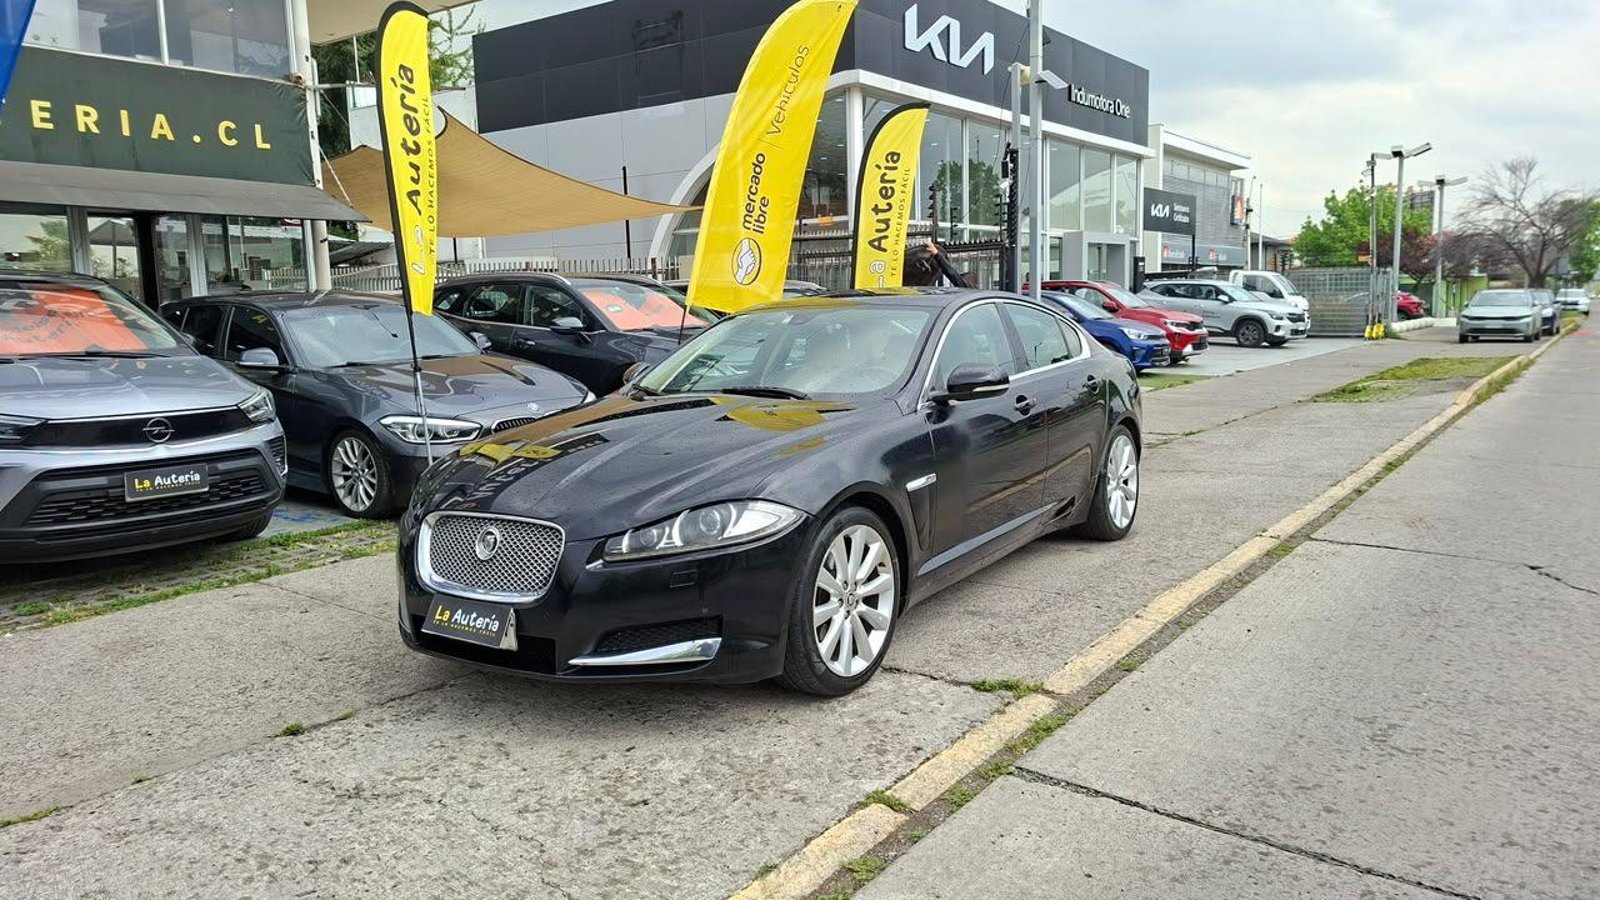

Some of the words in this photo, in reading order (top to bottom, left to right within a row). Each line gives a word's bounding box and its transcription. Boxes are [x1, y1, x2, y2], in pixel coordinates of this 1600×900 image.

[905, 4, 994, 75] KIA
[1070, 84, 1115, 114] Indumotora
[1115, 97, 1131, 119] One
[30, 99, 272, 149] ERIA.CL
[390, 64, 421, 216] Autería
[427, 140, 435, 208] HACEMOS
[742, 153, 766, 231] mercado
[752, 196, 770, 234] libre
[868, 151, 901, 253] Autería
[1151, 203, 1170, 218] KIA
[427, 215, 436, 232] LO
[895, 198, 906, 246] HACEMOS
[891, 266, 898, 277] TE
[893, 249, 899, 262] LO
[134, 478, 151, 489] La
[154, 470, 201, 487] Autería
[434, 605, 451, 622] La
[451, 609, 500, 632] Autería
